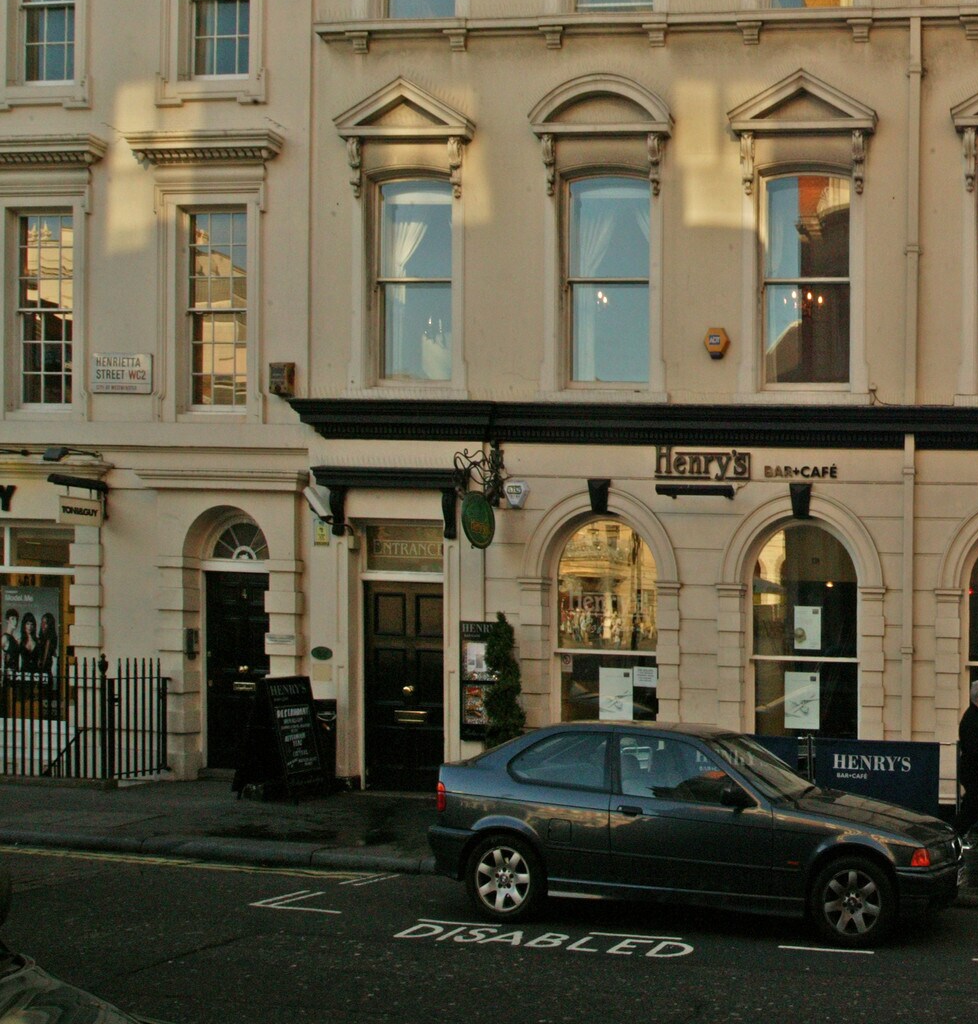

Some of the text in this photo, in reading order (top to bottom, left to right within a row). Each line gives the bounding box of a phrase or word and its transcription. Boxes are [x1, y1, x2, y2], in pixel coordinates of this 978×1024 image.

[96, 357, 141, 367] HENRIETTA
[96, 369, 147, 380] STREET WC2
[654, 445, 748, 481] Henry's
[61, 505, 98, 516] TONI&GUY
[832, 753, 912, 772] HENRY'S
[393, 923, 695, 958] DISABLED
